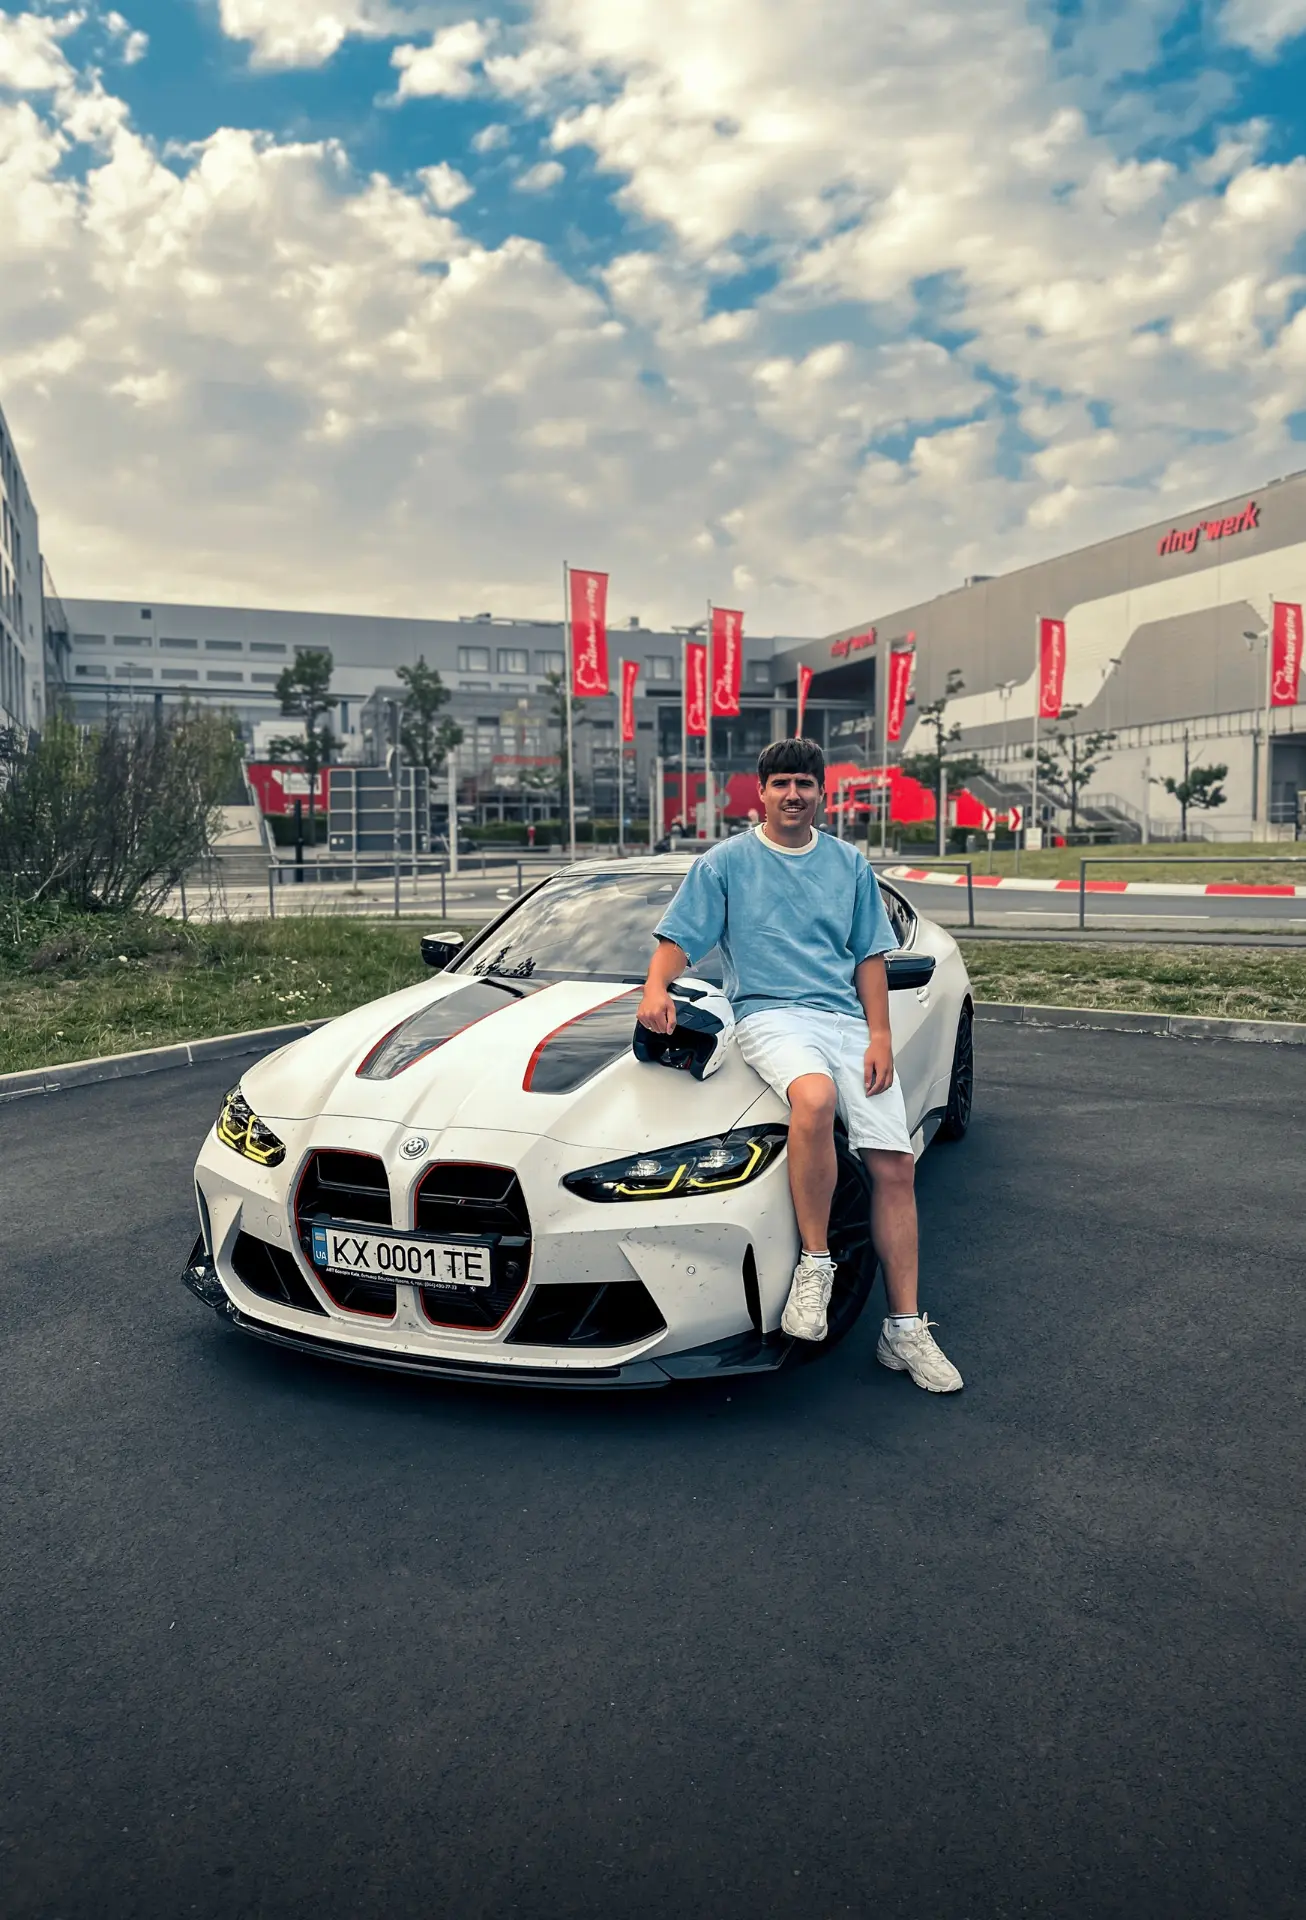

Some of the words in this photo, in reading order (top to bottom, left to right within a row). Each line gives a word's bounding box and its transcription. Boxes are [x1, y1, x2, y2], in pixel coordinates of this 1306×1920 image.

[1284, 607, 1297, 684] nürburgring
[315, 1250, 327, 1260] UA
[333, 1235, 370, 1268] KX
[377, 1242, 436, 1277] 0001
[443, 1250, 485, 1282] TE
